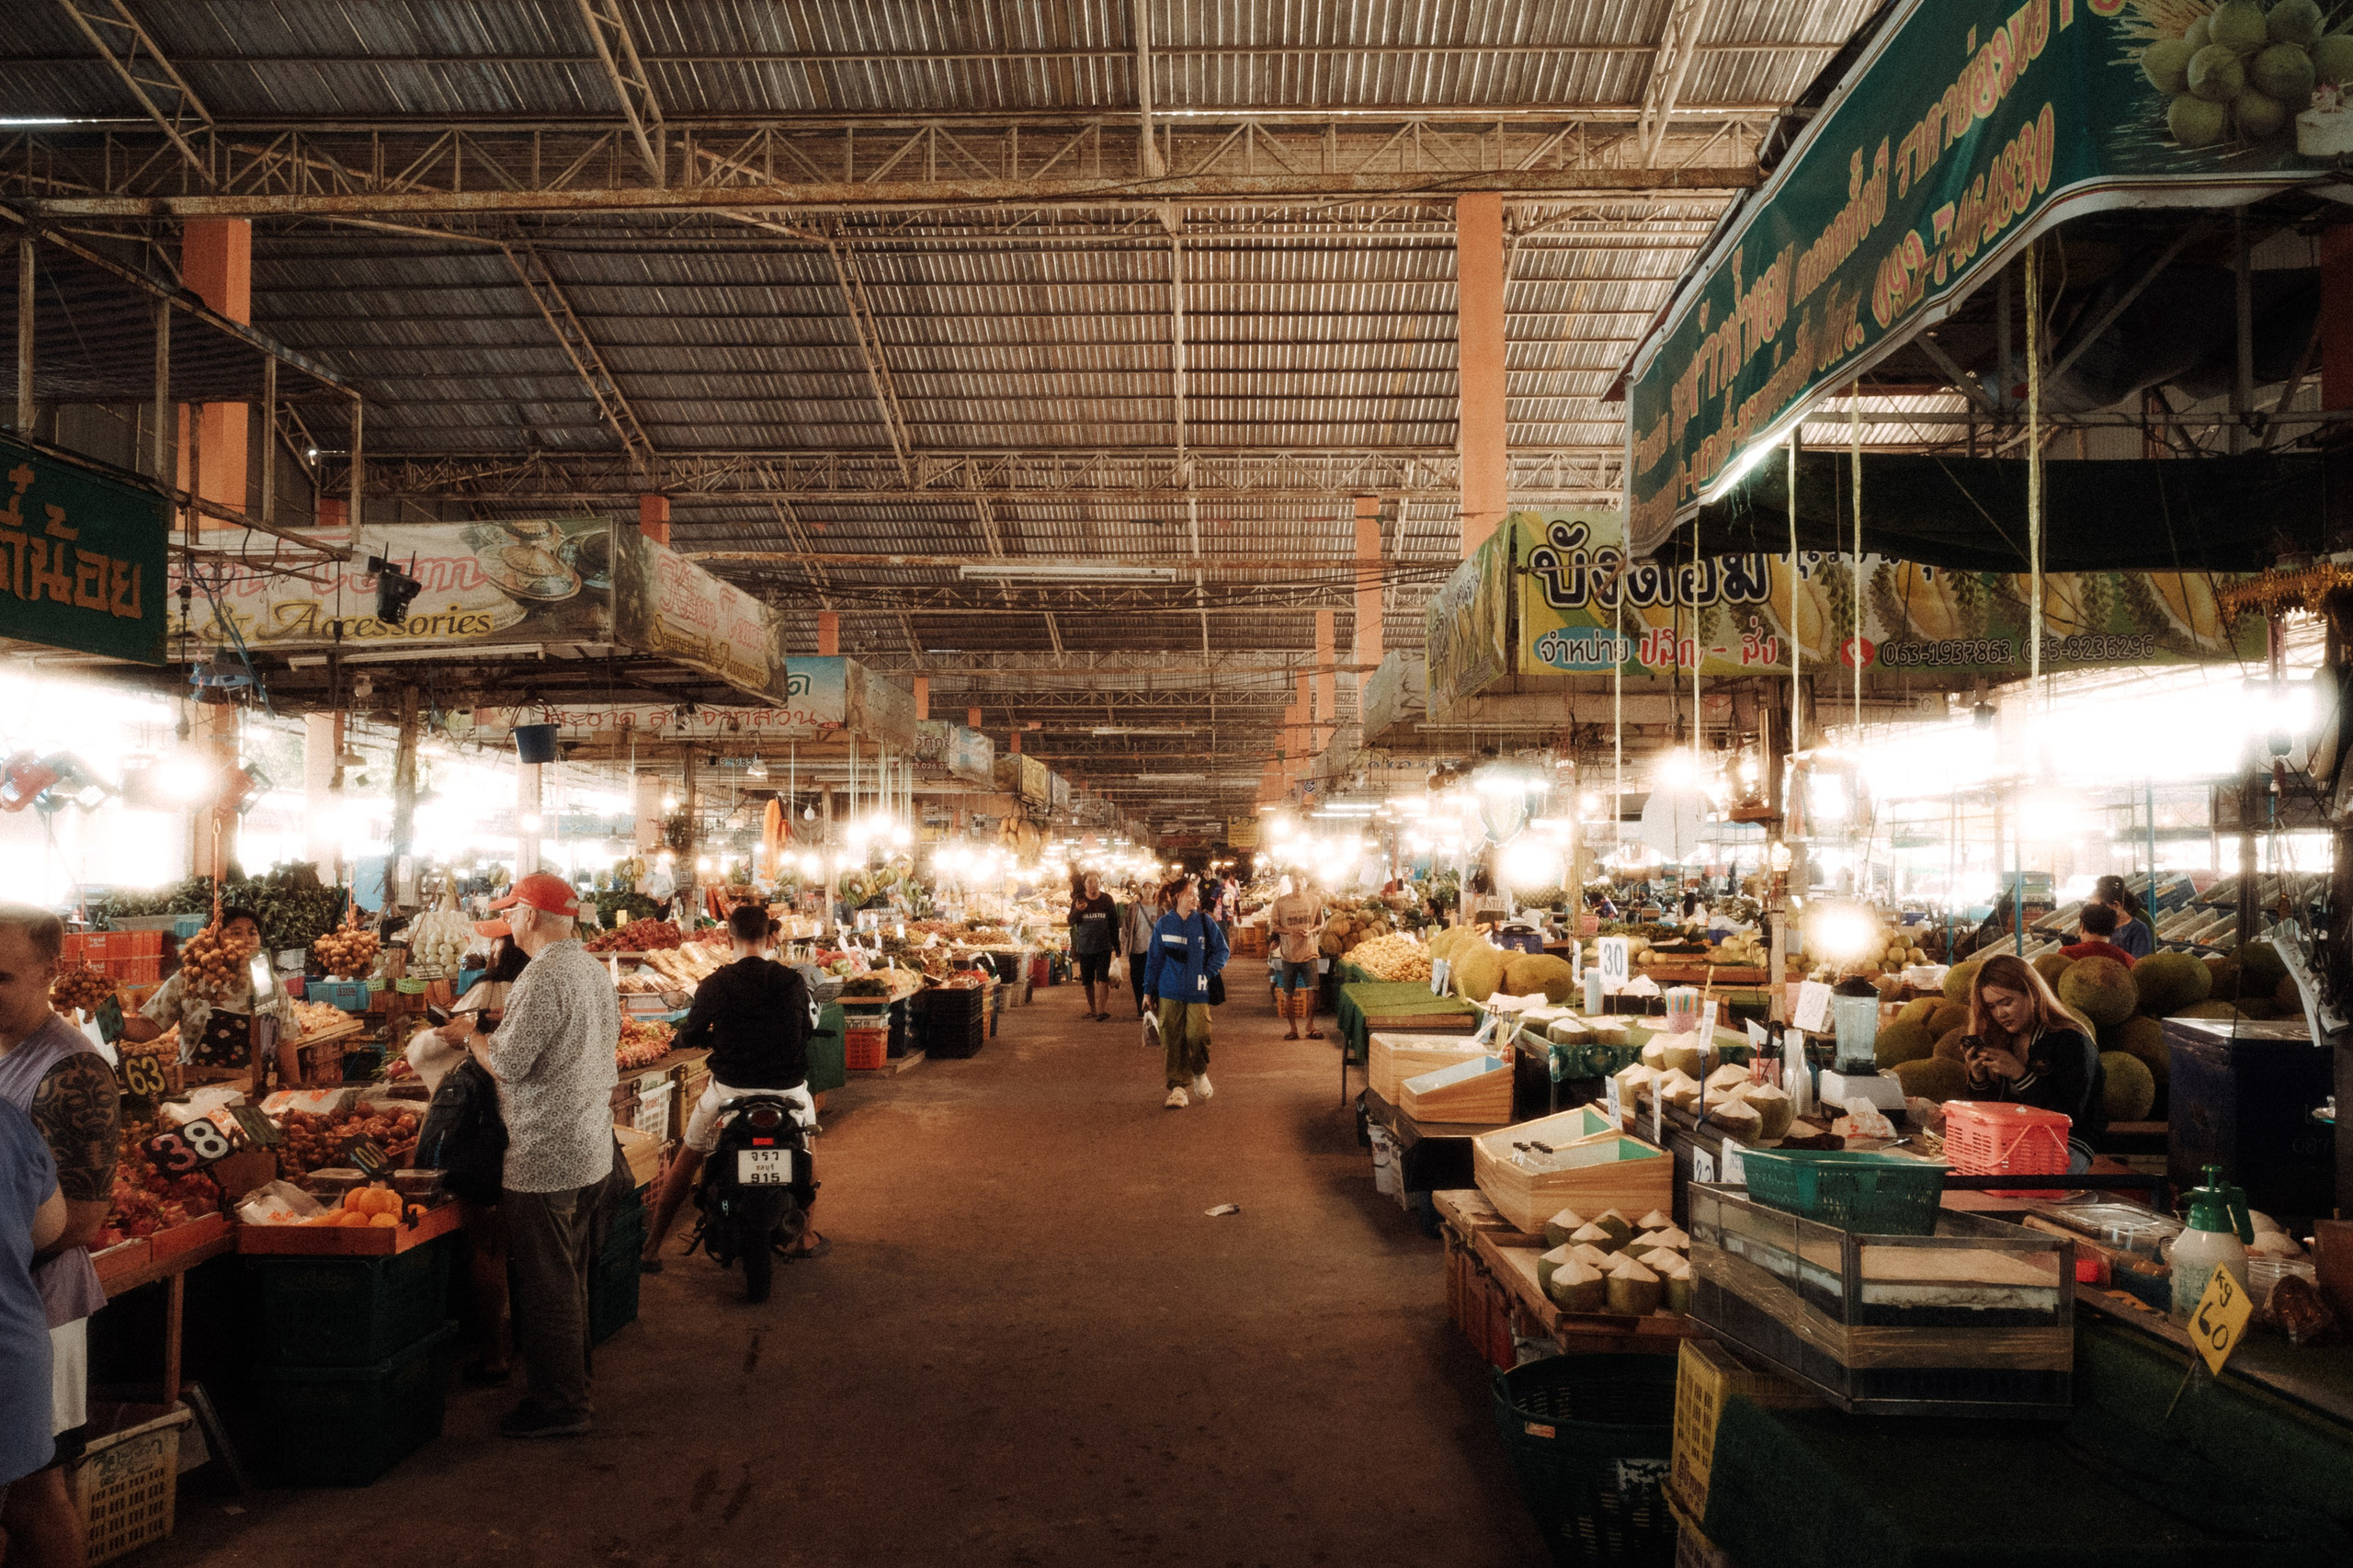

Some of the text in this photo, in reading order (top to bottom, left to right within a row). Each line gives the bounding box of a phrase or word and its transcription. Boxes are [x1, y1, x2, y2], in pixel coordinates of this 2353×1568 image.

[1794, 134, 1890, 307] ตลอดทั้งปี
[1872, 102, 2055, 329] 092-7464830
[256, 599, 493, 641] Accessories
[657, 553, 765, 653] Khun Team
[1540, 630, 1631, 664] จำหน่าย
[1743, 617, 1778, 665] ส่ง
[1602, 940, 1624, 978] 30
[1802, 985, 1825, 1019] 30
[125, 1055, 166, 1096] 63
[151, 1119, 230, 1172] 38
[349, 1141, 389, 1175] 100
[751, 1172, 780, 1184] 915
[2198, 1301, 2229, 1351] 60
